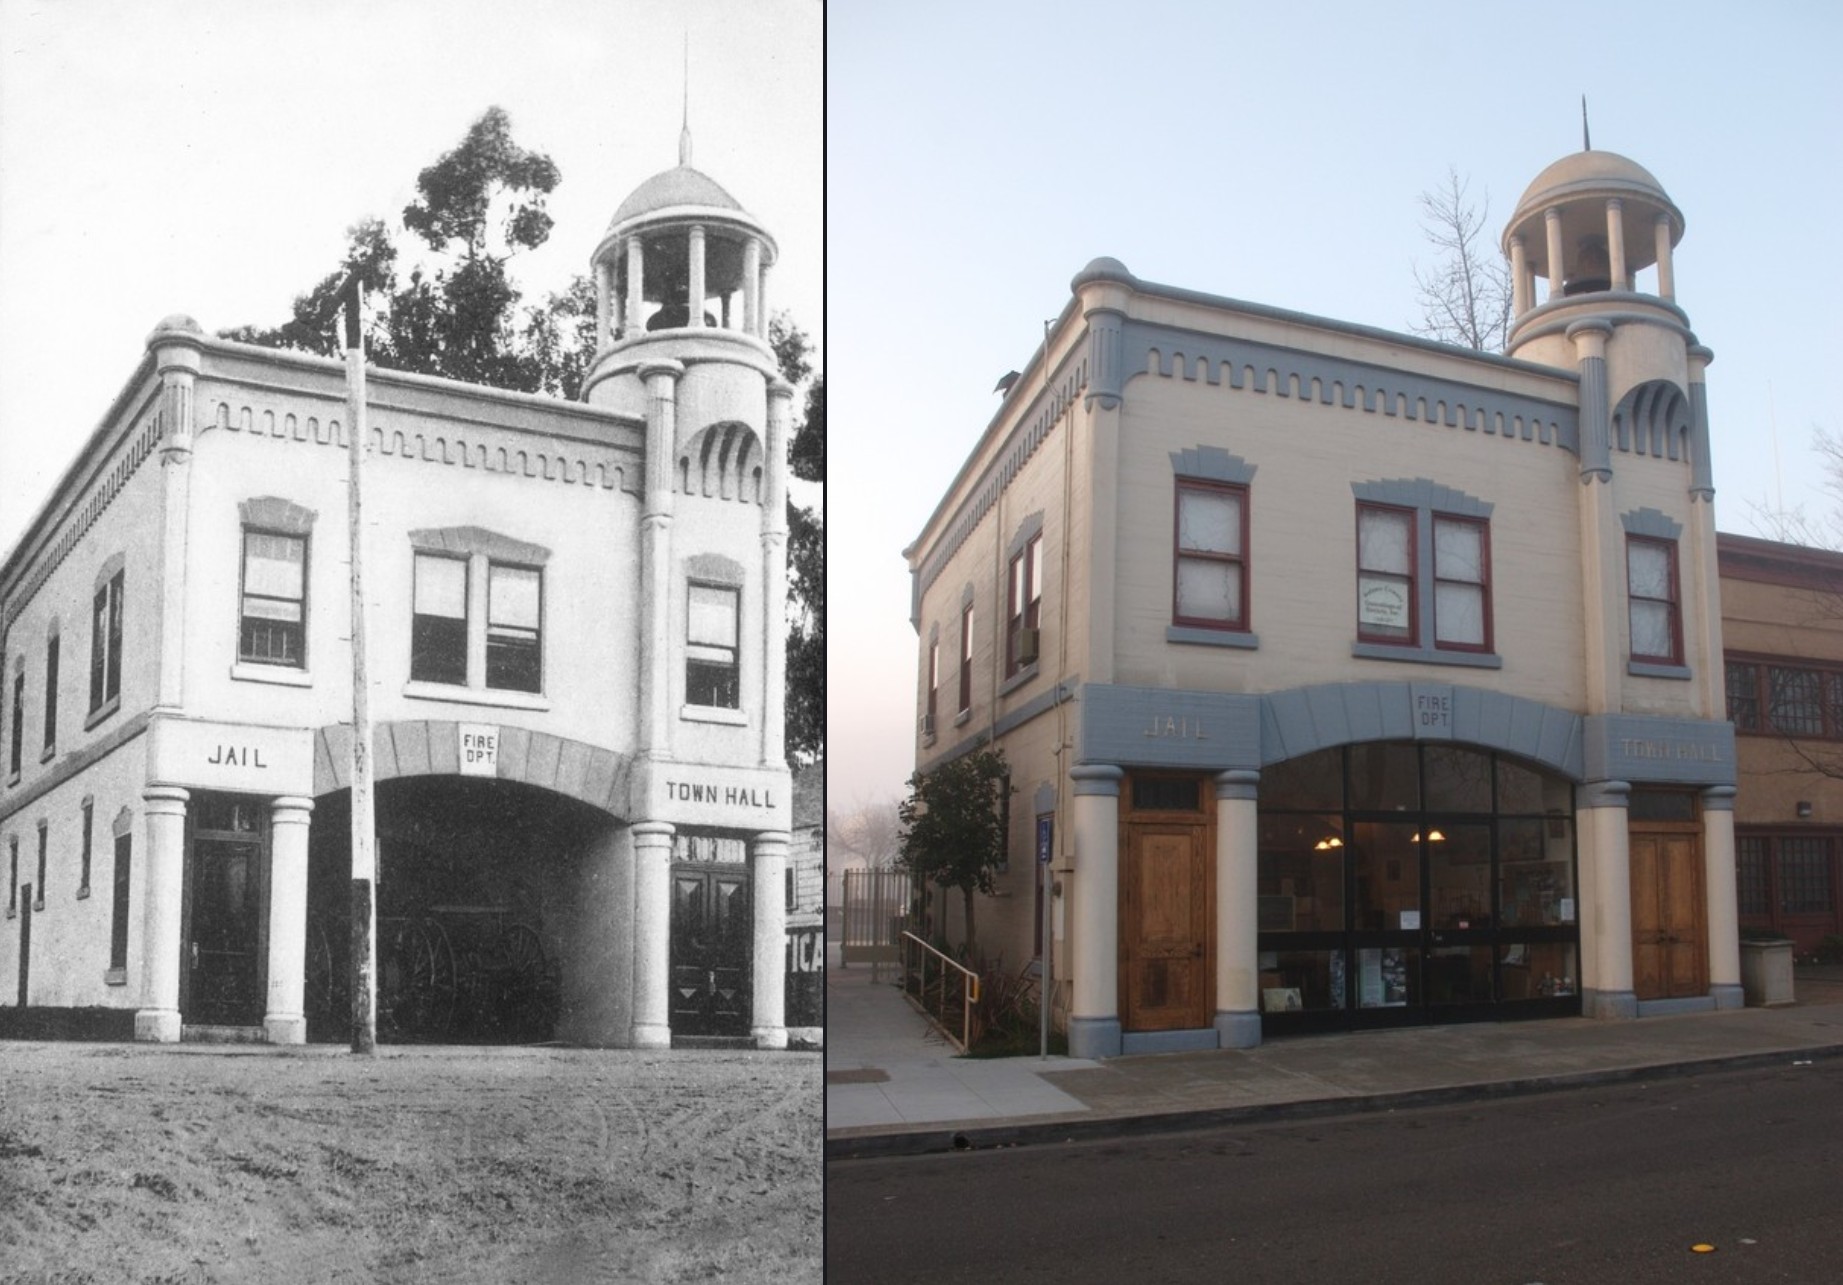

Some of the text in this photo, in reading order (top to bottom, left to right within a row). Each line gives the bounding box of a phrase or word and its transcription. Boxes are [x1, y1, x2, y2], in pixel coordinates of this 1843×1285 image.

[1417, 695, 1449, 711] FIRE
[1143, 715, 1208, 739] JAIL
[463, 734, 495, 749] FIRE
[1621, 739, 1724, 762] TOWN HALL
[208, 744, 268, 769] JAIL
[466, 749, 496, 764] DPT.
[666, 781, 776, 809] TOWN HALL
